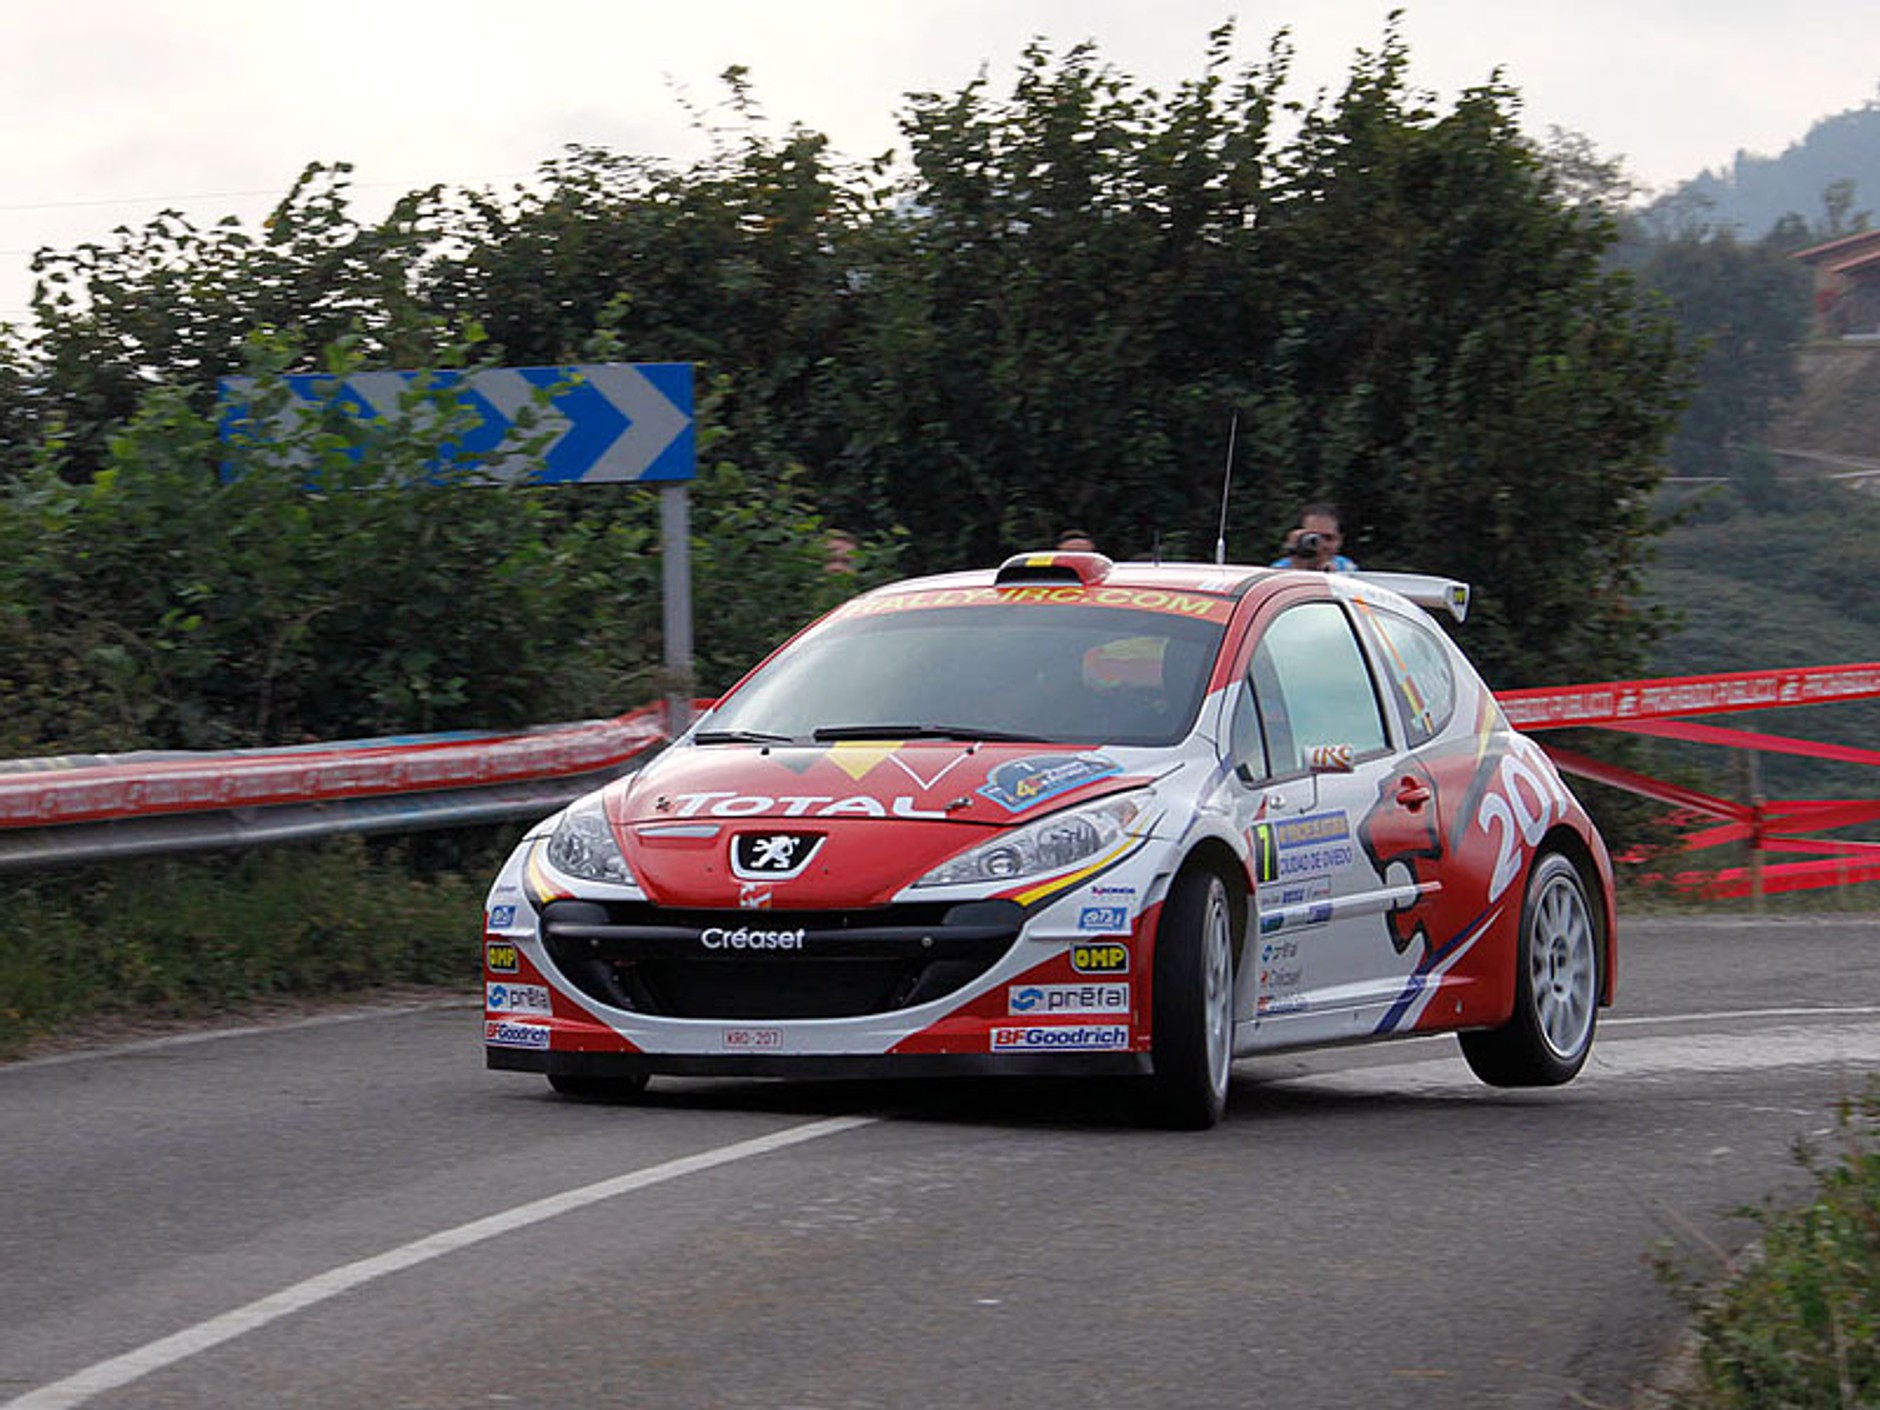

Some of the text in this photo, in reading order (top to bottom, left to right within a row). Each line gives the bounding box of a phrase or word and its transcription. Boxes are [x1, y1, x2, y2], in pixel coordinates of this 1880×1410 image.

[674, 791, 946, 819] TOTAL
[1470, 738, 1567, 904] 207
[701, 926, 806, 949] Créaset
[488, 947, 515, 968] OMP
[1074, 948, 1126, 968] OMP
[487, 1022, 549, 1043] BFGoodrich
[996, 1027, 1127, 1045] BFGoodrich
